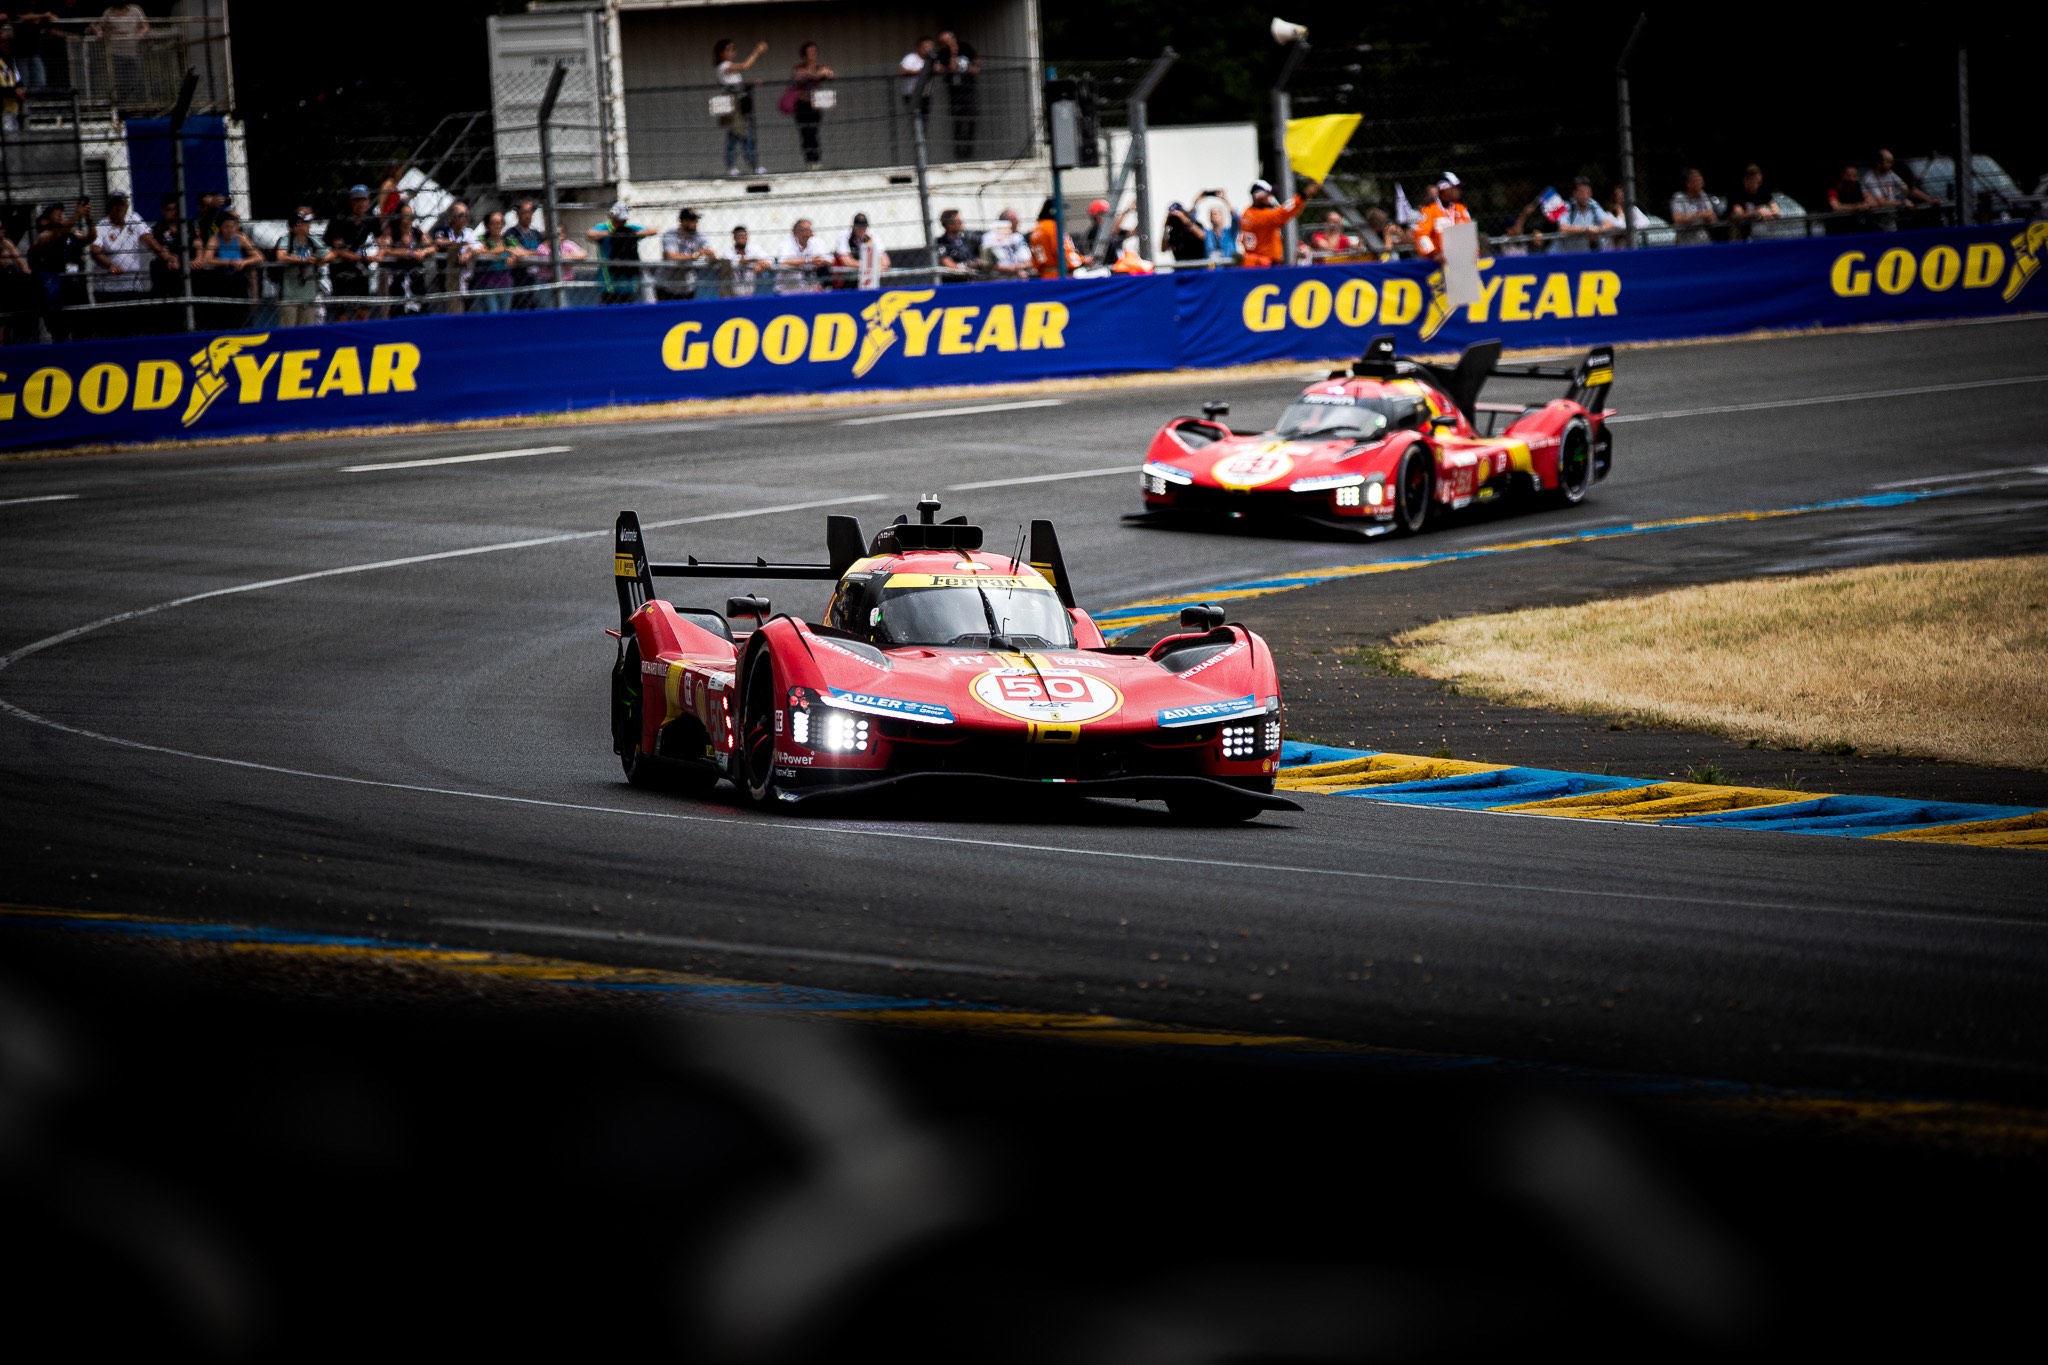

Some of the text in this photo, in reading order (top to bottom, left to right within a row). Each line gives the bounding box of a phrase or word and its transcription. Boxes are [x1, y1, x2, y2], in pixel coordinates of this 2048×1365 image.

[1830, 242, 2005, 298] GOOD
[1243, 270, 1621, 332] GOOD YEAR
[661, 301, 1070, 371] GOOD YEAR
[234, 342, 421, 404] YEAR
[930, 575, 1028, 588] Ferrari
[801, 631, 891, 673] RICHARD MILLE
[1178, 640, 1249, 680] RICHARD MILLE
[836, 694, 900, 709] ADLER
[1001, 677, 1086, 698] 50
[710, 700, 726, 743] 50
[1164, 704, 1218, 720] ADLER
[778, 752, 814, 765] V-Power
